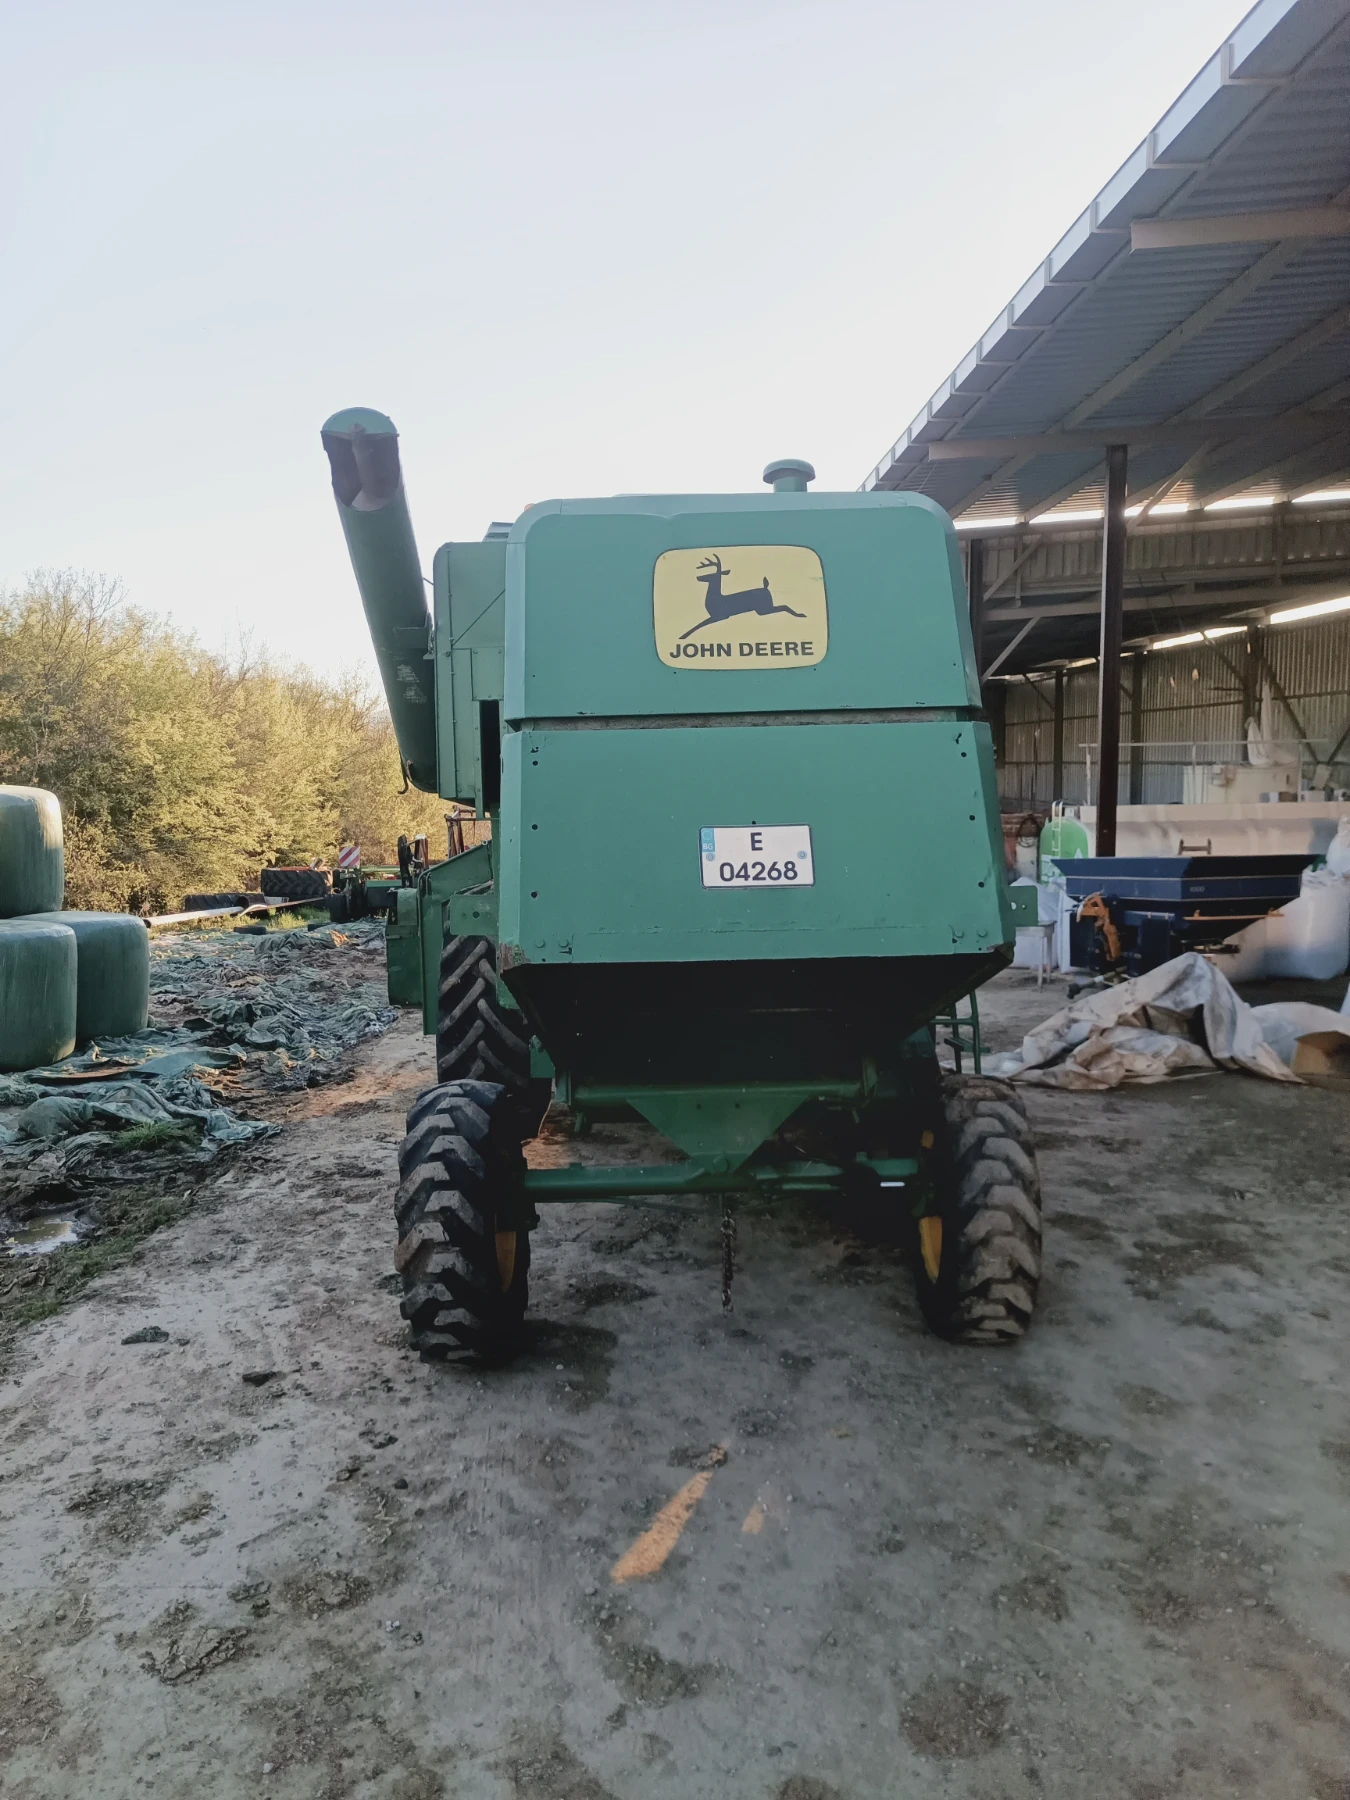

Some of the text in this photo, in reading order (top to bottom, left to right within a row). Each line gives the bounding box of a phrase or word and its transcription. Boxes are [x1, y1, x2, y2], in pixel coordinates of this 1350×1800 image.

[669, 641, 814, 658] JOHN DEERE
[750, 832, 763, 851] E
[719, 861, 798, 882] 04268
